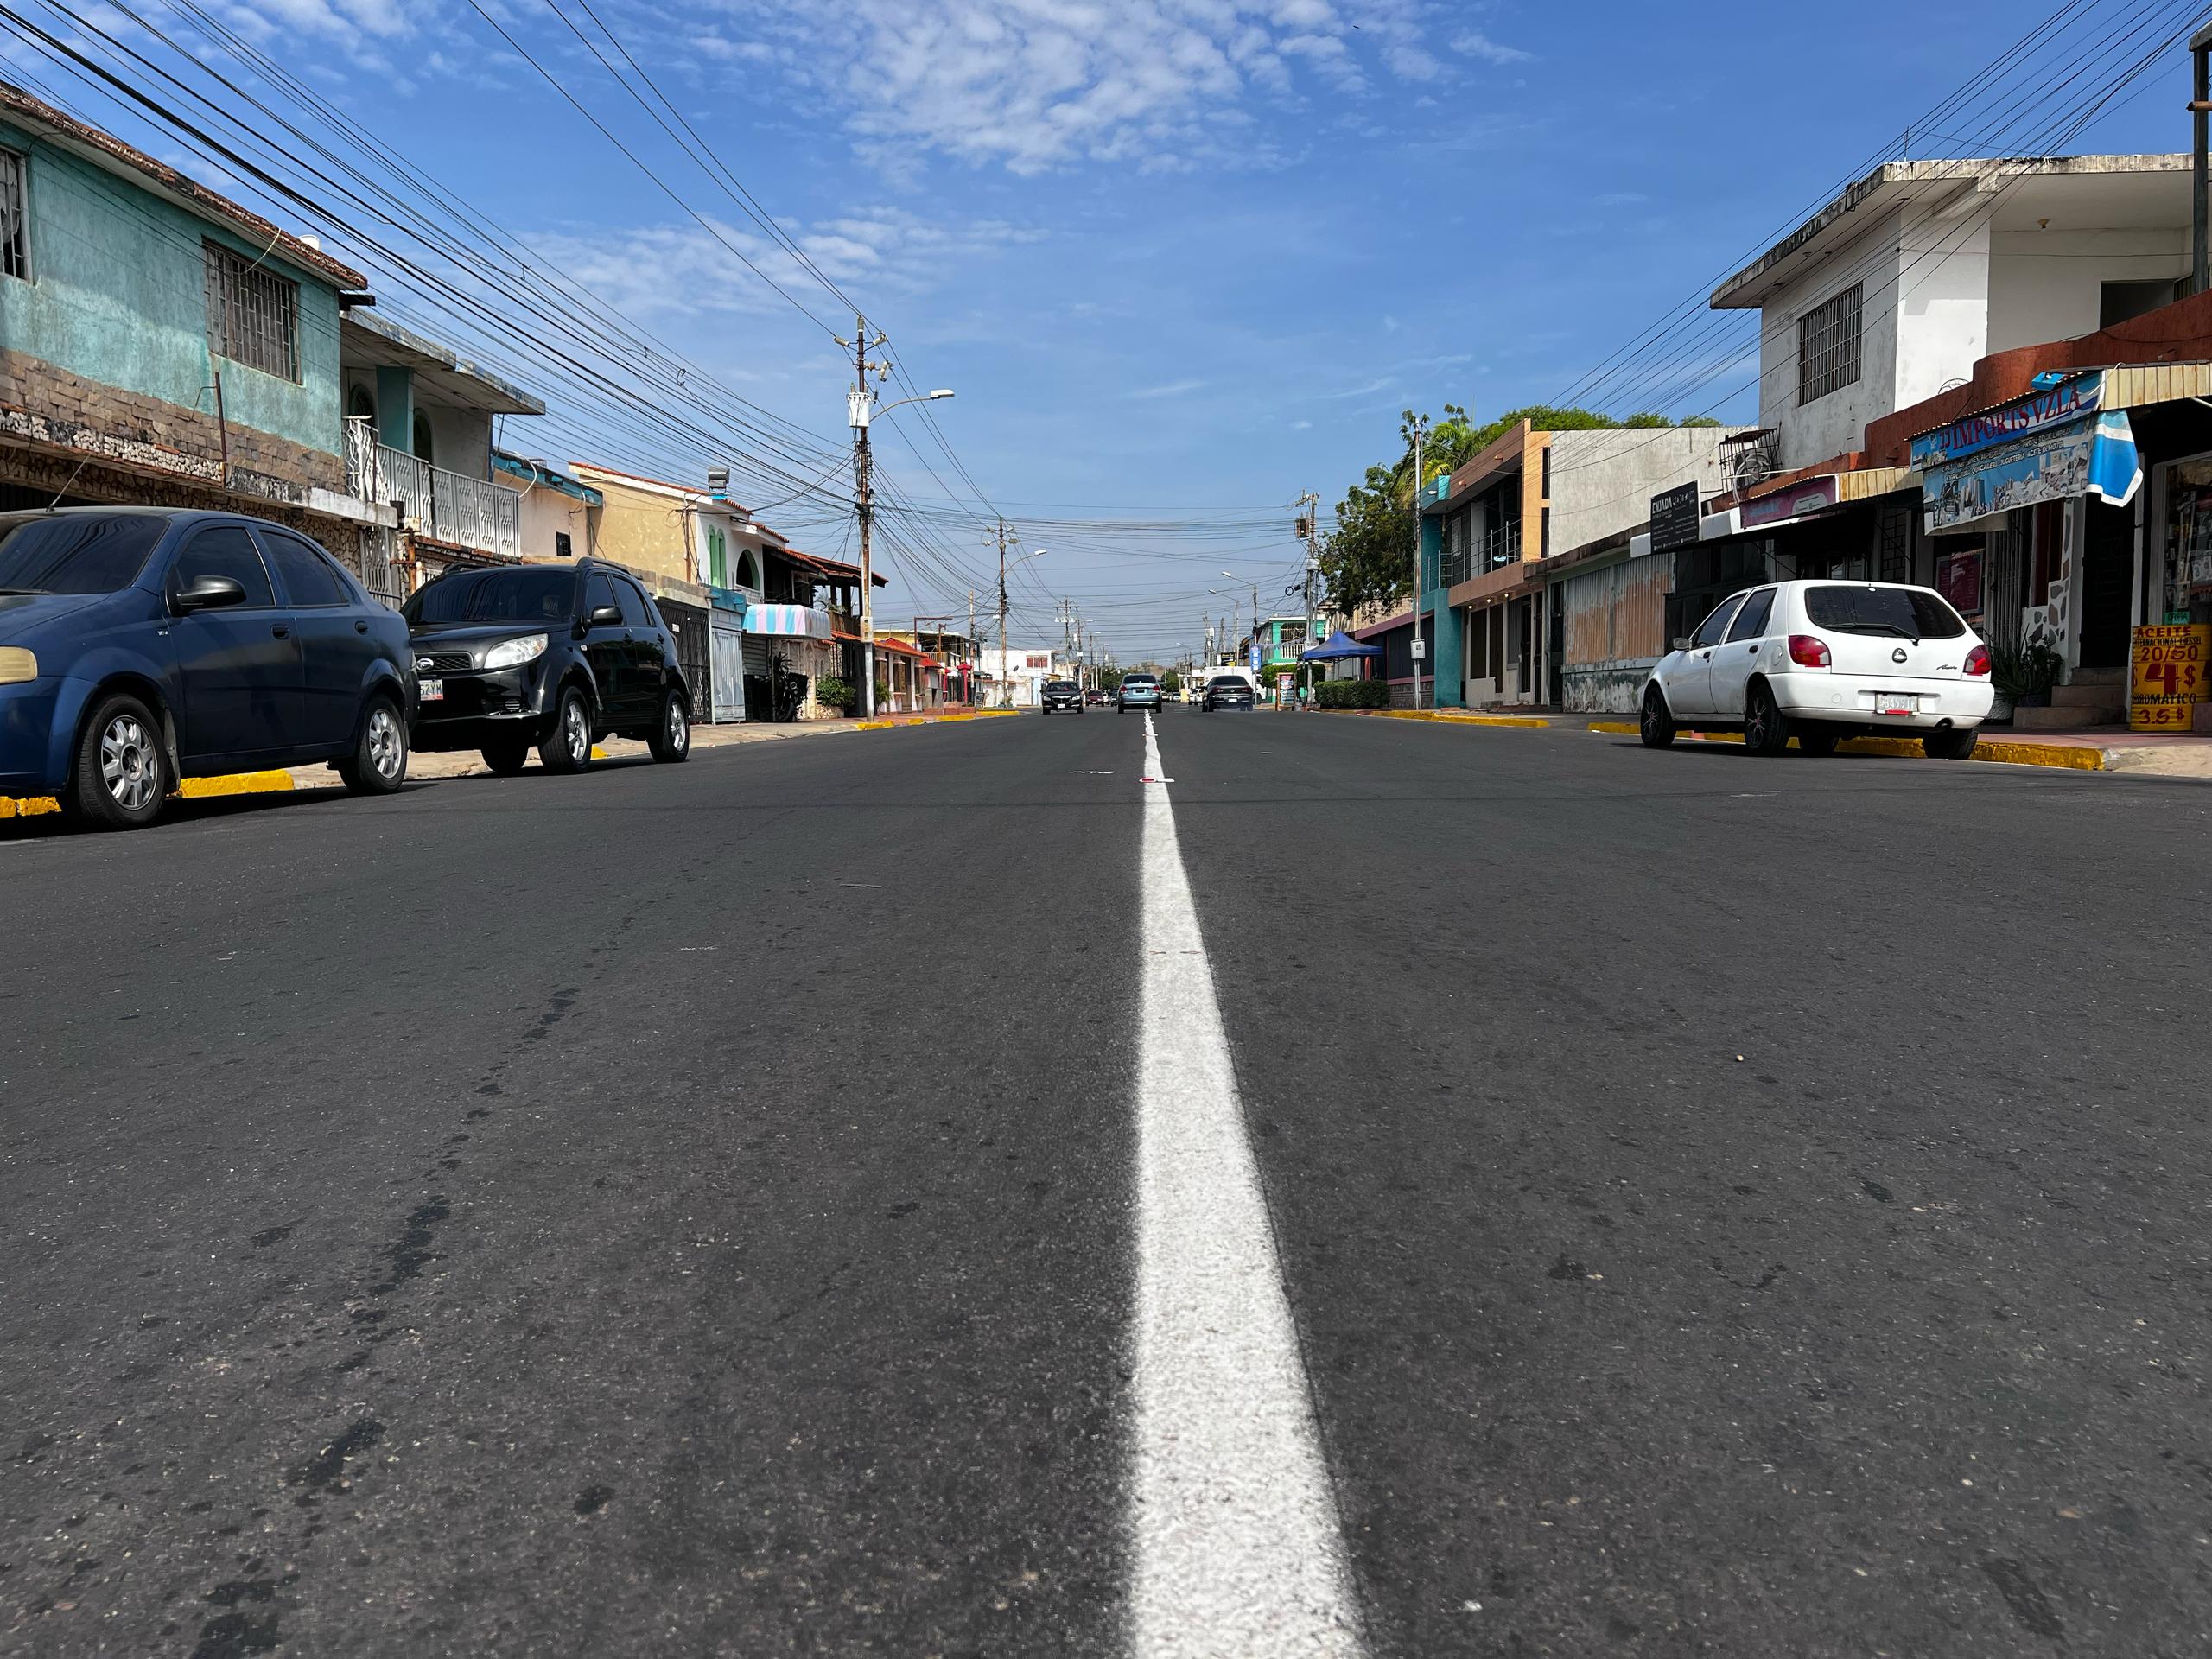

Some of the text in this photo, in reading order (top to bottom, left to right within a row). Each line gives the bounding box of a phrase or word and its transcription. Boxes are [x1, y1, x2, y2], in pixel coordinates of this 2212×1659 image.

[1953, 405, 2030, 450] IMPORTS
[2031, 384, 2082, 423] VZLA
[2137, 626, 2192, 638] ACEITE
[2140, 645, 2199, 663] 20/50
